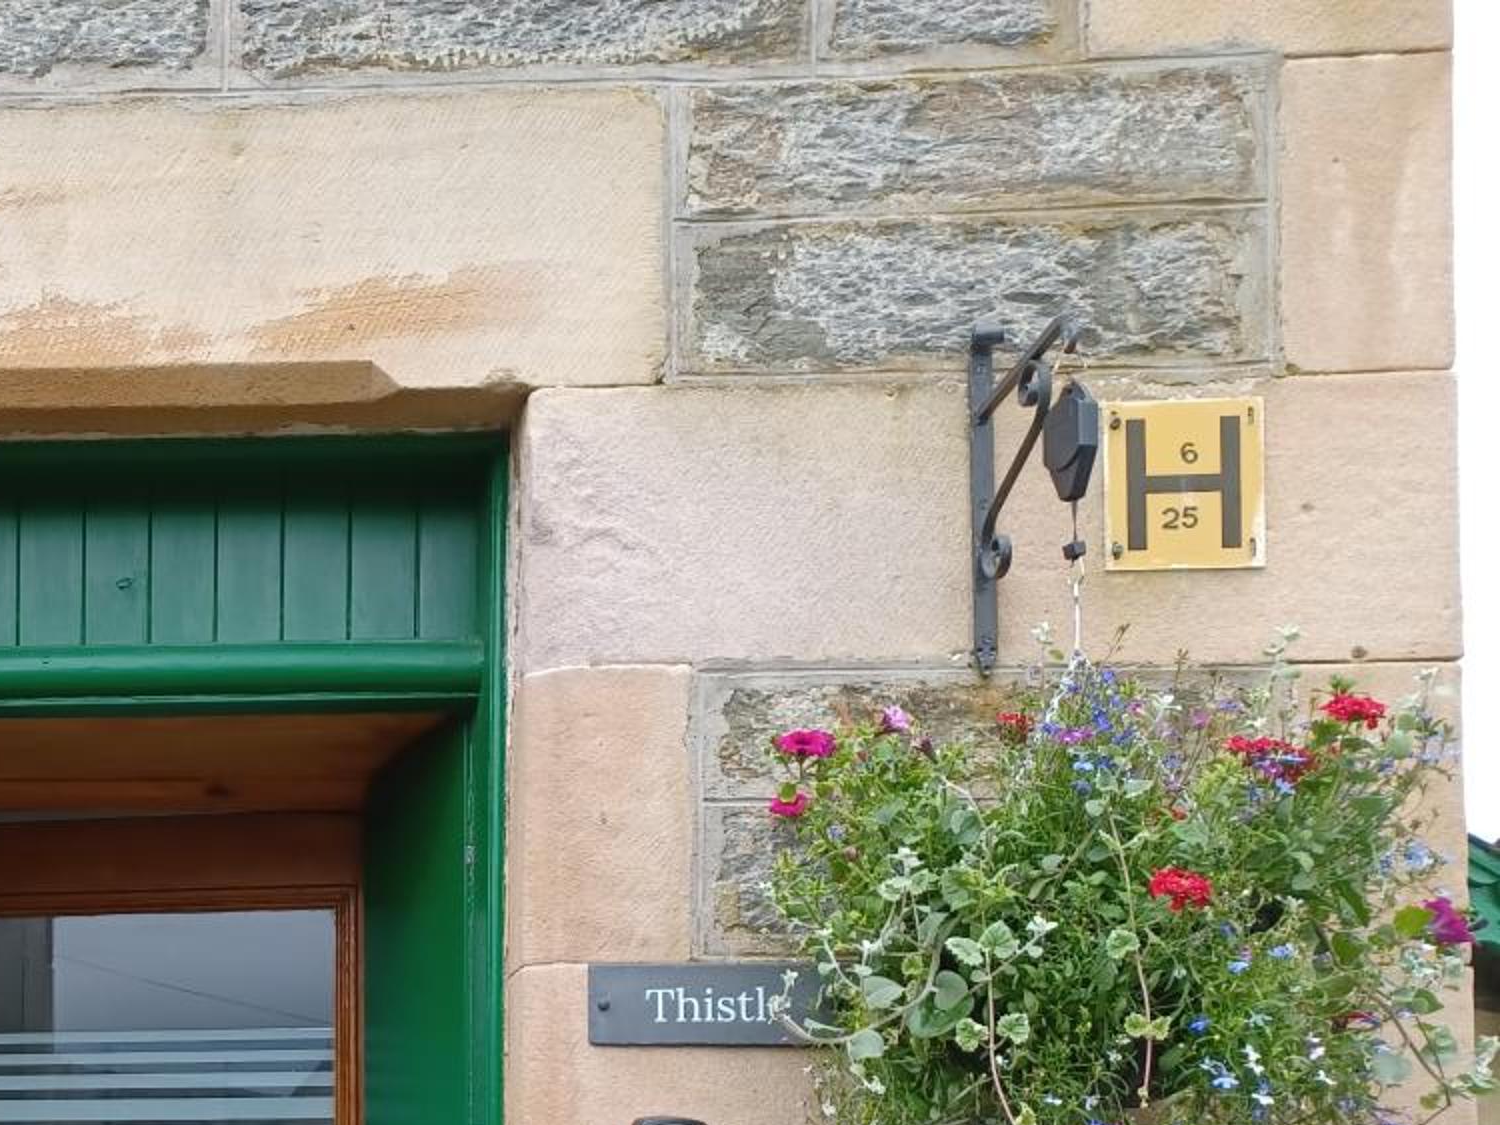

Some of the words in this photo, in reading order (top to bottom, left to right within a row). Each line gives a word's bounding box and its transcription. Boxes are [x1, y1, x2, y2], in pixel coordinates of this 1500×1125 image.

[1180, 442, 1199, 464] 6
[1126, 416, 1242, 551] H
[1161, 506, 1199, 530] 25
[645, 987, 788, 1023] Thistl
